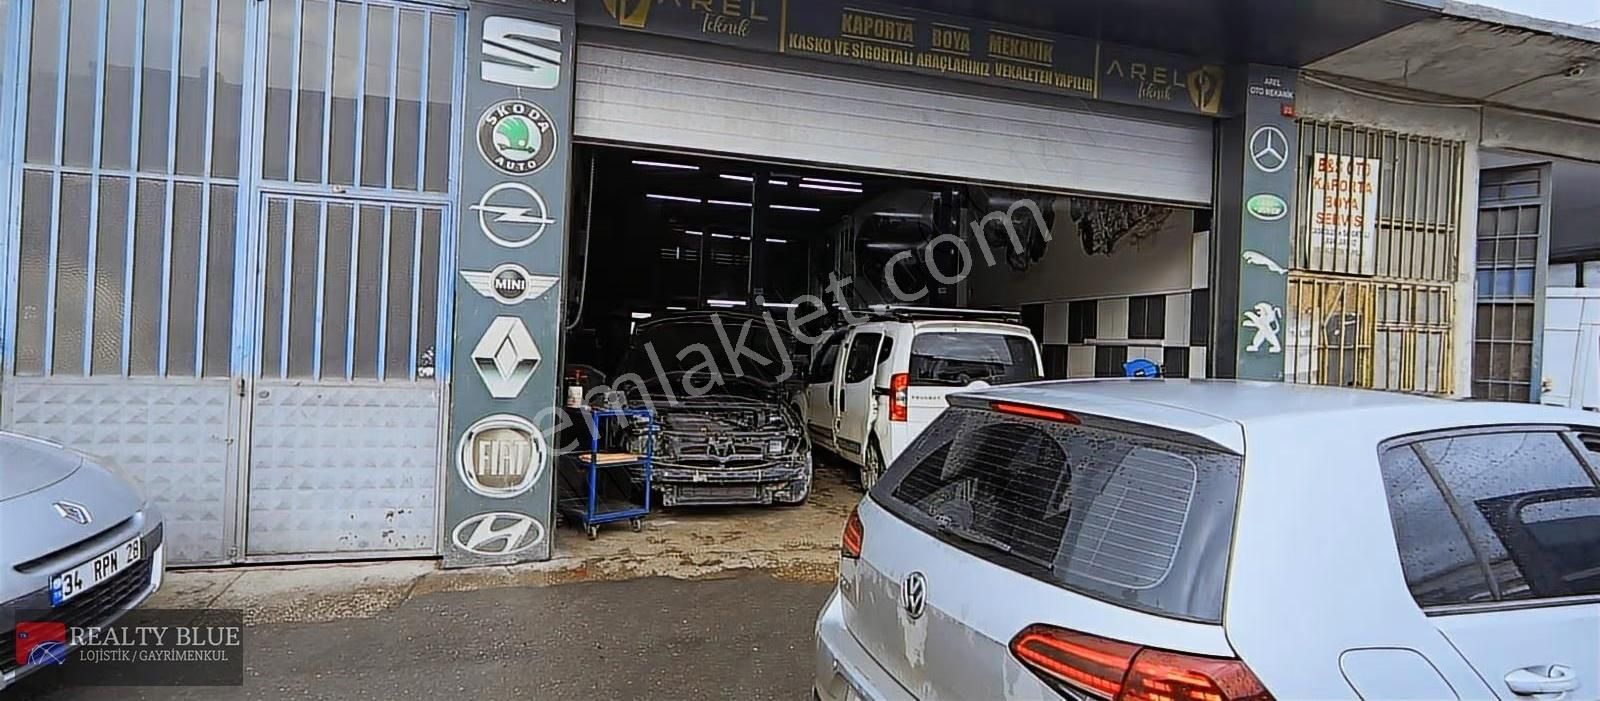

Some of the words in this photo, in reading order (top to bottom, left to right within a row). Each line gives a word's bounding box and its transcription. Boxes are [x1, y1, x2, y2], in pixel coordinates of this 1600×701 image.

[702, 13, 750, 37] Teknik
[841, 14, 914, 42] KAPORTA
[932, 27, 970, 51] BOYA
[988, 34, 1054, 62] MEKANİK
[789, 33, 831, 54] KASKO
[834, 41, 850, 57] VE
[852, 41, 913, 65] SİGORTALI
[916, 54, 990, 77] ARAÇLARINIZ
[995, 62, 1052, 84] VEKALETEN
[1054, 71, 1094, 92] YAPILIR
[1106, 60, 1186, 88] AREL
[1250, 86, 1264, 95] OTO
[495, 157, 536, 171] AUTO
[1327, 196, 1358, 210] BOYA
[495, 279, 525, 291] MINI
[478, 440, 529, 476] FIAT
[64, 571, 82, 596] 34
[94, 551, 118, 582] RPN
